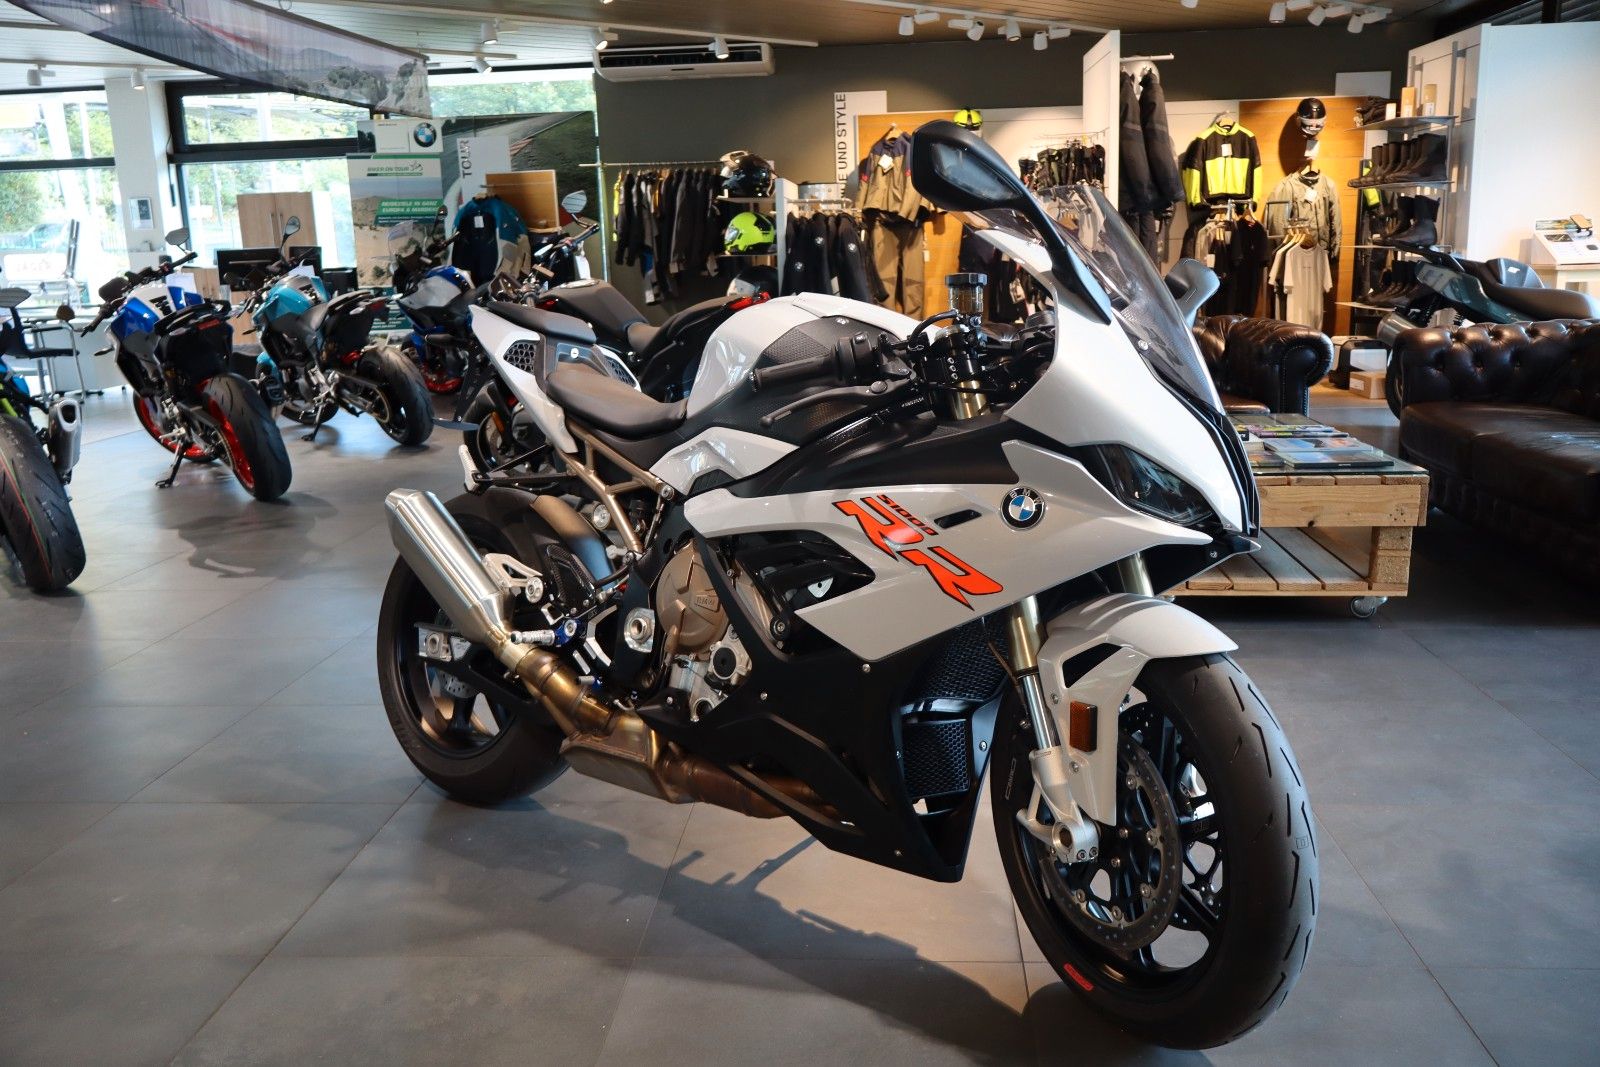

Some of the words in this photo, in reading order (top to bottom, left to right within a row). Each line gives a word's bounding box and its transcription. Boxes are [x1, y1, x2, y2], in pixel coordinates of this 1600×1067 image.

[836, 93, 847, 137] STYLE
[460, 140, 472, 179] TOUR
[837, 141, 848, 170] UND
[876, 494, 939, 537] S1000
